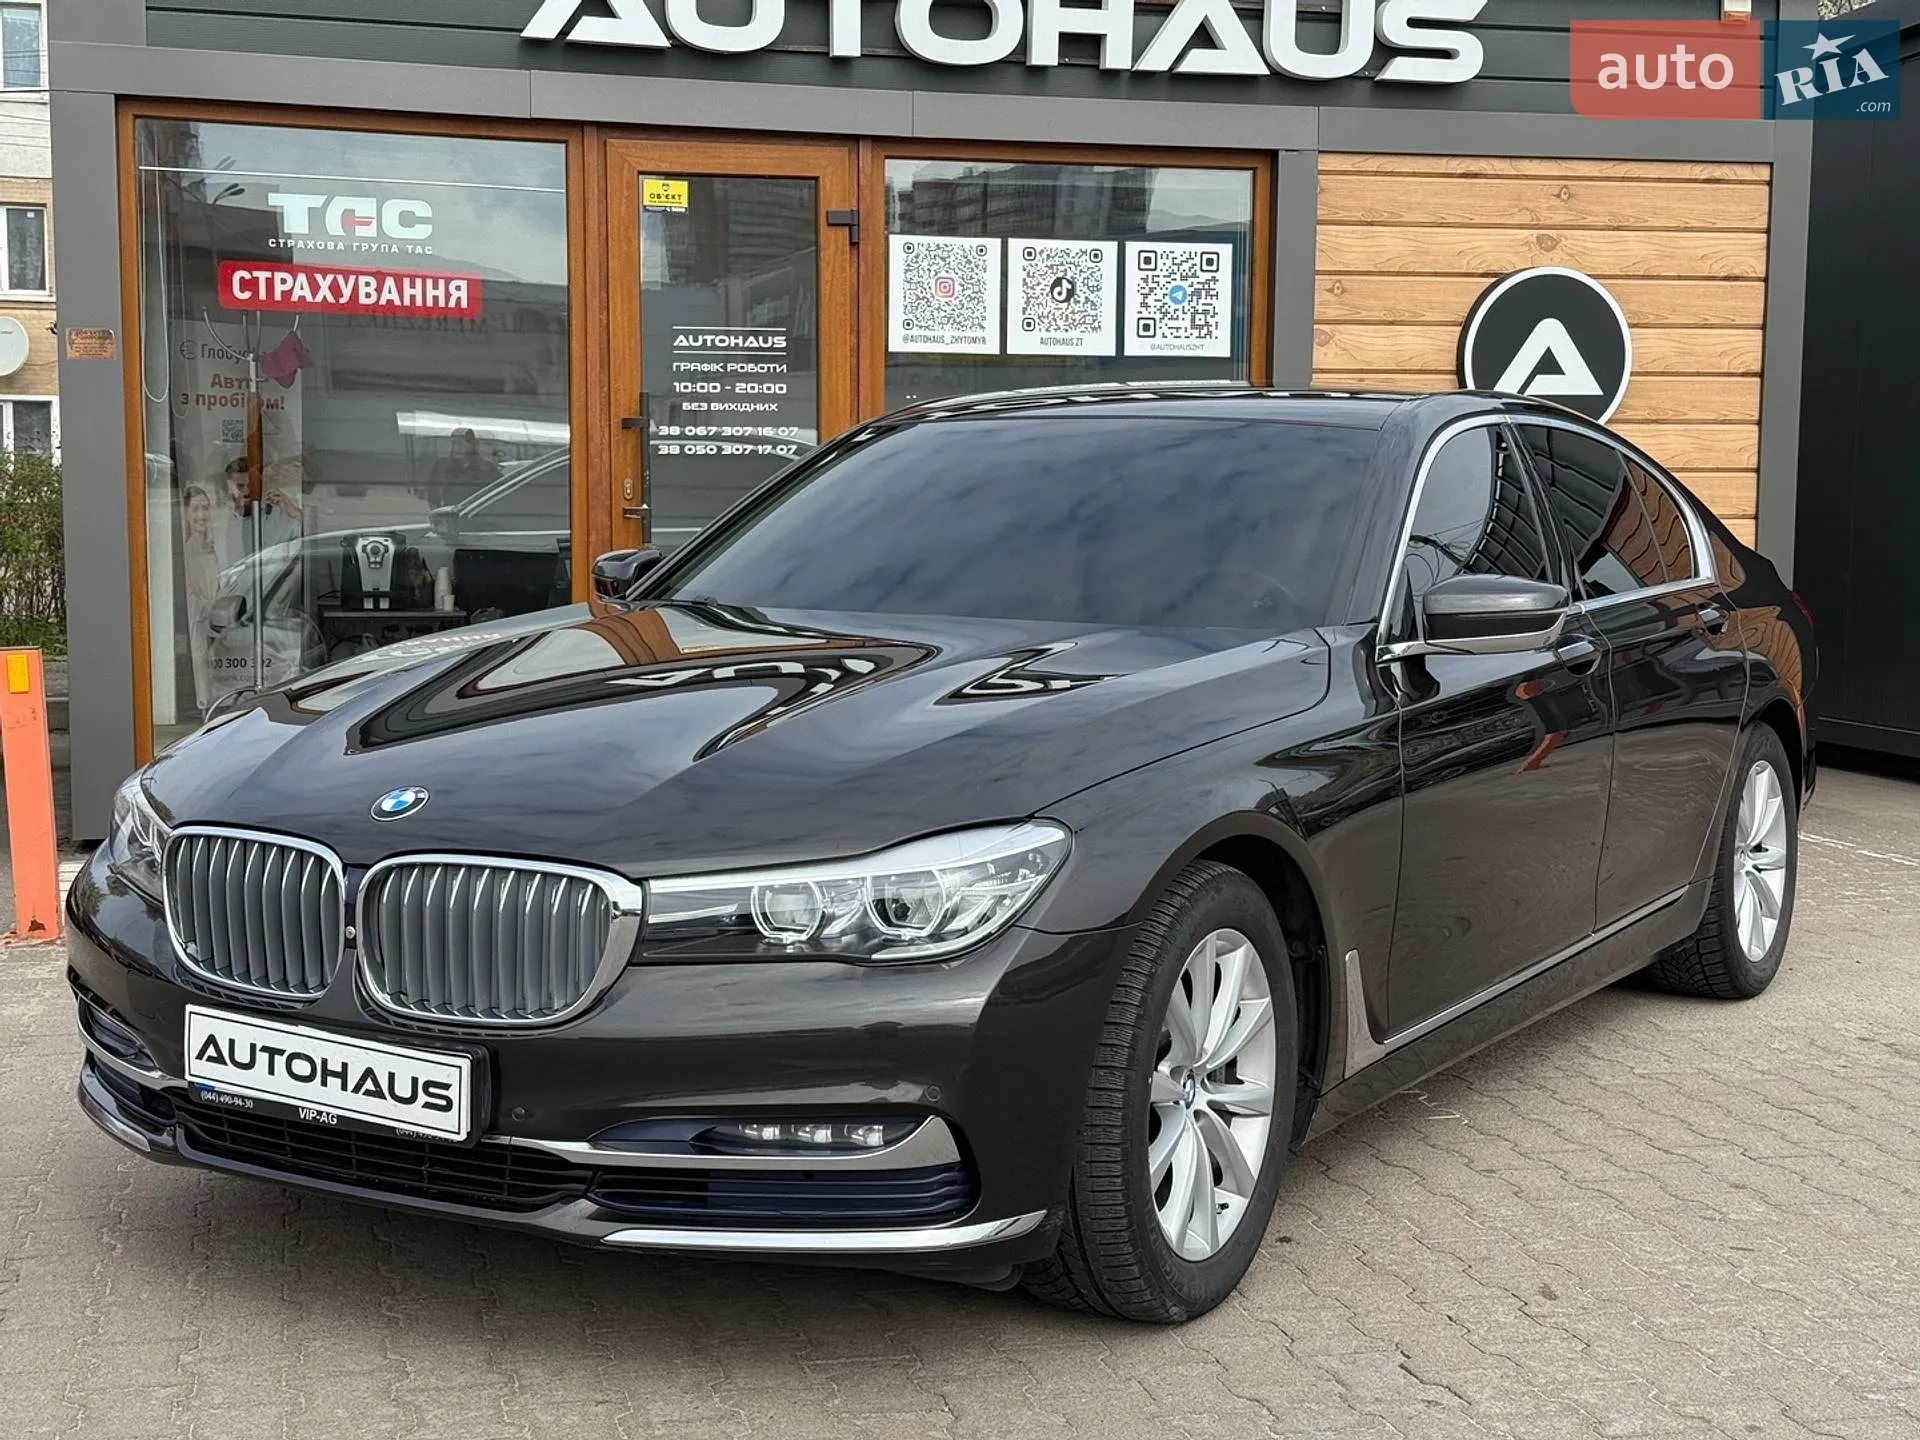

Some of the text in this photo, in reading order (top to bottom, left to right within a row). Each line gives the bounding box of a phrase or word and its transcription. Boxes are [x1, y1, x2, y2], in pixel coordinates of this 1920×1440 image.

[268, 192, 433, 240] ТАС
[268, 238, 433, 255] СТРАХОВА ГРУПА ТАС
[232, 269, 468, 309] СТРАХУВАННЯ
[673, 334, 787, 348] AUTOHAUS
[902, 333, 987, 346] @AUTOHAUS_ZHYTOMYR
[1039, 336, 1074, 347] AUTOHAUS
[673, 362, 787, 373] ГРАФІК РОБОТИ
[673, 382, 721, 393] 10:00
[735, 383, 787, 394] 20:00
[682, 402, 778, 412] БЕЗ ВИХІДНИХ
[658, 426, 799, 437] 38 067 307 16 07
[658, 445, 798, 455] 38 050 307 17 07
[195, 1033, 454, 1113] AUTOHAUS
[298, 1107, 338, 1125] VIP-AG
